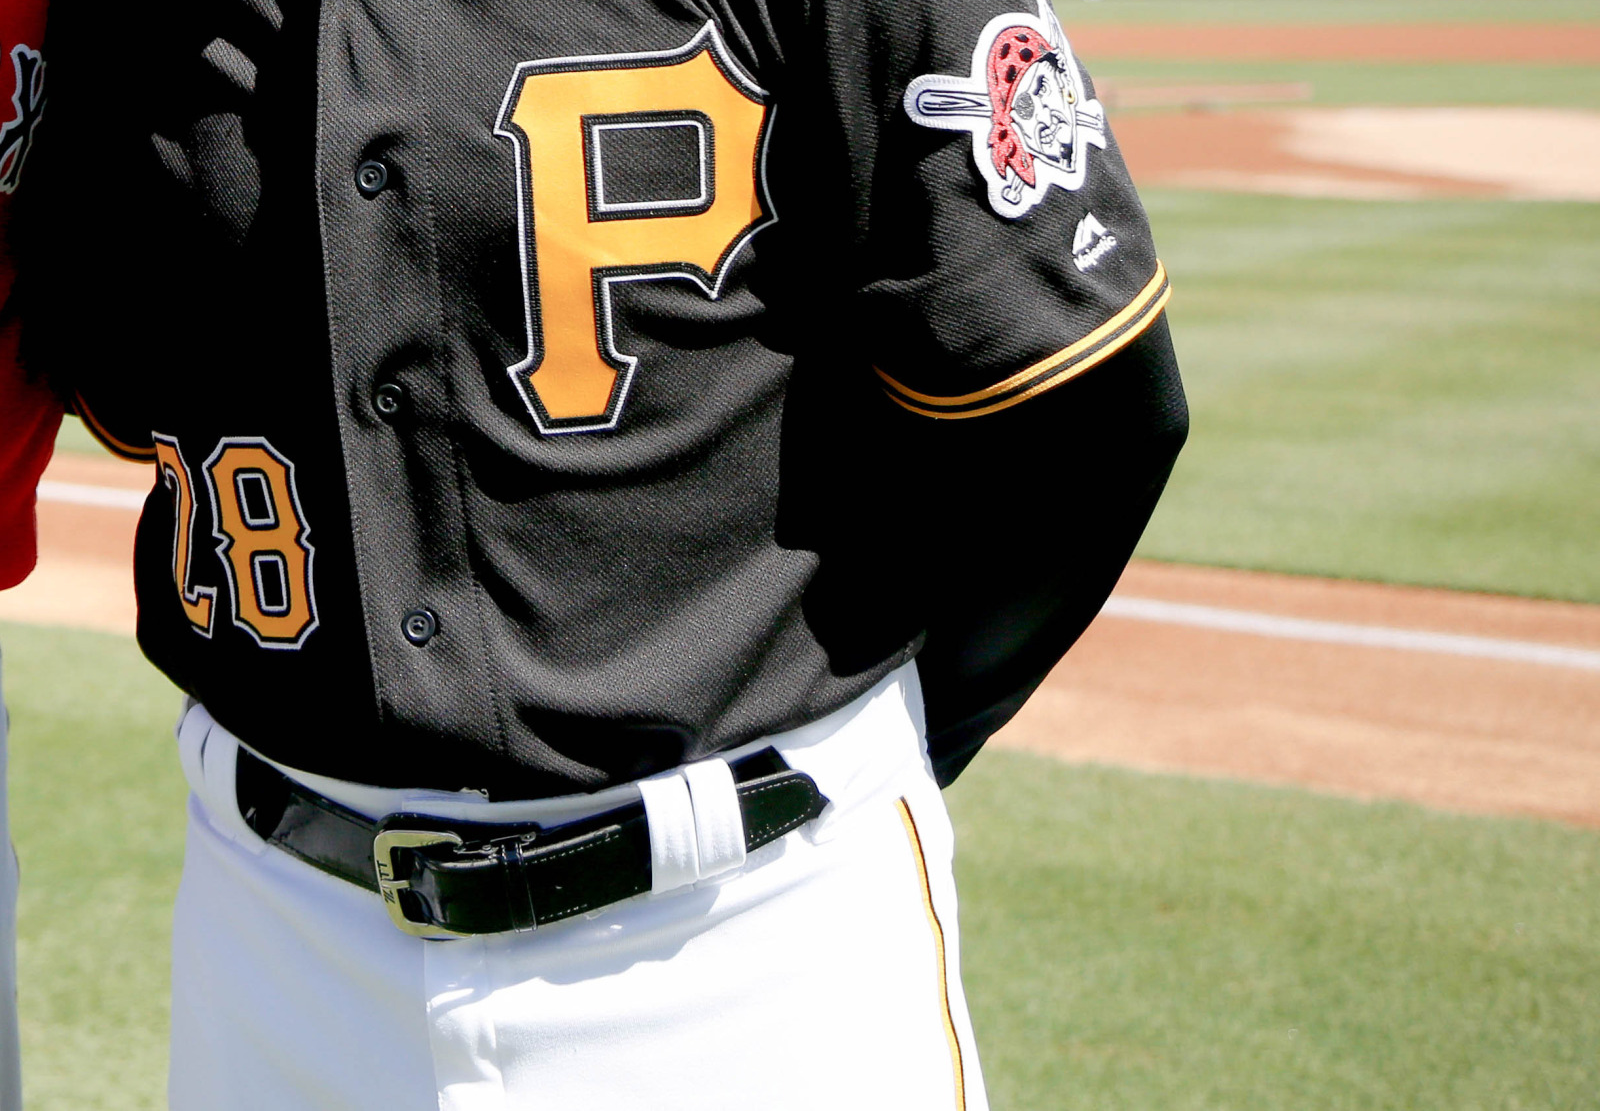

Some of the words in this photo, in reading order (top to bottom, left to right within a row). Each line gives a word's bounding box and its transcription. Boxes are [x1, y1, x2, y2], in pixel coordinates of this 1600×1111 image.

[493, 19, 779, 435] P
[1072, 235, 1117, 273] Majestic
[151, 430, 320, 650] 28
